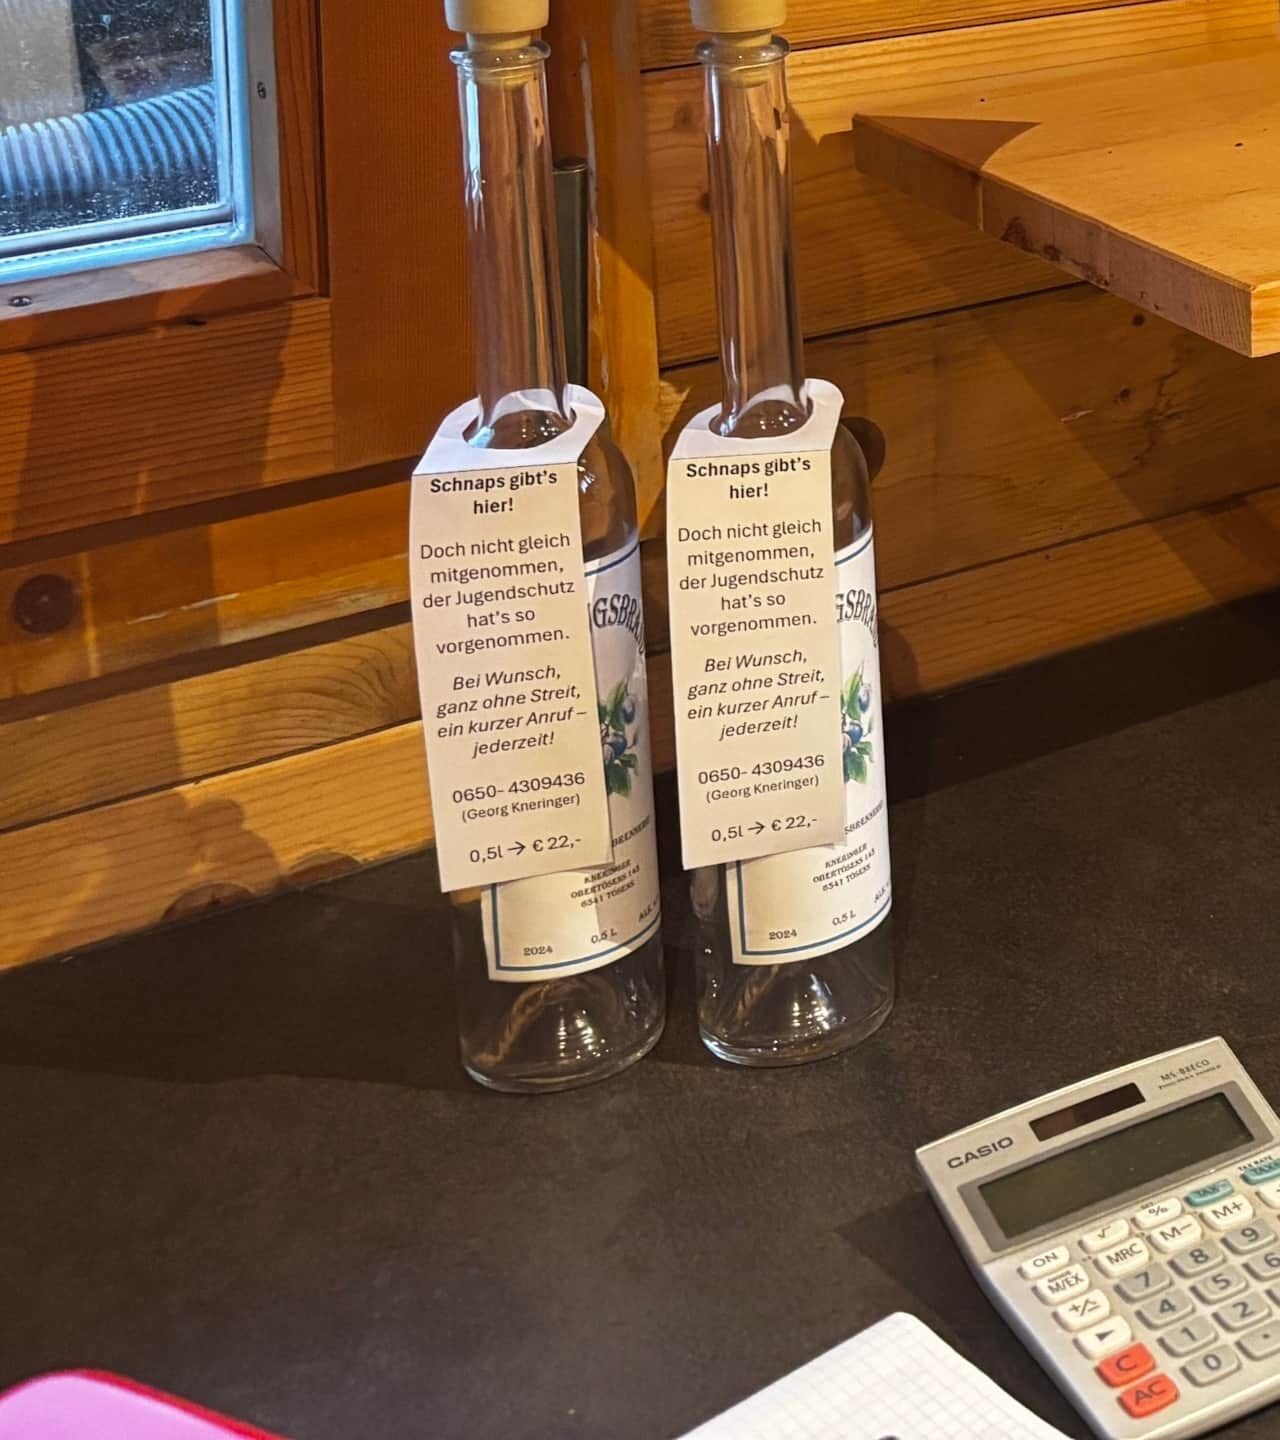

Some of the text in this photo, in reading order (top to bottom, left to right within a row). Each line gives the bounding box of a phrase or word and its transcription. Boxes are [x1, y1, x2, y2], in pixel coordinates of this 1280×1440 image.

[686, 457, 811, 478] Schnaps gibt's
[430, 470, 557, 493] Schnaps gibt's
[730, 483, 769, 499] hier!
[474, 498, 513, 514] hier!
[678, 519, 822, 542] Doch nicht gleich
[421, 533, 571, 559] Doch nicht gleich
[688, 545, 815, 567] mitgenommen,
[431, 560, 564, 584] mitgenommen,
[679, 567, 824, 590] der Jugendschutz
[423, 581, 575, 608] der Jugendschutz
[721, 593, 785, 611] hat's so
[467, 610, 535, 628] hat's so
[691, 613, 817, 636] vorgenommen.
[436, 629, 570, 654] vorgenommen.
[704, 649, 808, 673] Bei Wunsch,
[453, 665, 561, 690] Bei Wunsch,
[687, 670, 825, 700] ganz ohne Streit,
[436, 686, 581, 718] ganz ohne Streit,
[688, 705, 712, 719] ein
[717, 698, 769, 716] kurzer
[438, 723, 463, 738] ein
[468, 716, 523, 733] kurzer
[719, 715, 798, 741] jederzeit!
[472, 732, 554, 759] jederzeit!
[752, 755, 825, 776] 4309436
[509, 772, 585, 794] 4309436
[706, 775, 819, 803] (Georg Kneringer)
[462, 794, 581, 823] (Georg Kneringer)
[712, 826, 744, 842] 0,5l
[771, 819, 781, 832] €
[470, 844, 503, 863] 0,5l
[533, 839, 543, 852] €
[813, 857, 863, 883] OBERTÖSENS
[822, 864, 871, 892] 6541 TÖSENS
[581, 881, 635, 908] 6541 TÖSENS
[769, 929, 797, 940] 2024
[524, 946, 553, 956] 2024
[947, 1136, 1014, 1169] CASIO
[1212, 1202, 1243, 1219] M+
[1241, 1227, 1258, 1242] 9
[1033, 1253, 1058, 1267] ON
[1106, 1243, 1142, 1265] MRC
[1190, 1248, 1209, 1263] 8
[1048, 1273, 1083, 1294] M/EX
[1135, 1271, 1150, 1288] 7
[1211, 1273, 1230, 1291] 5
[1159, 1299, 1176, 1314] 4
[1232, 1301, 1254, 1318] 2
[1180, 1327, 1196, 1342] 1
[1116, 1354, 1136, 1372] C
[1203, 1353, 1222, 1370] 0
[1134, 1381, 1167, 1405] AC
